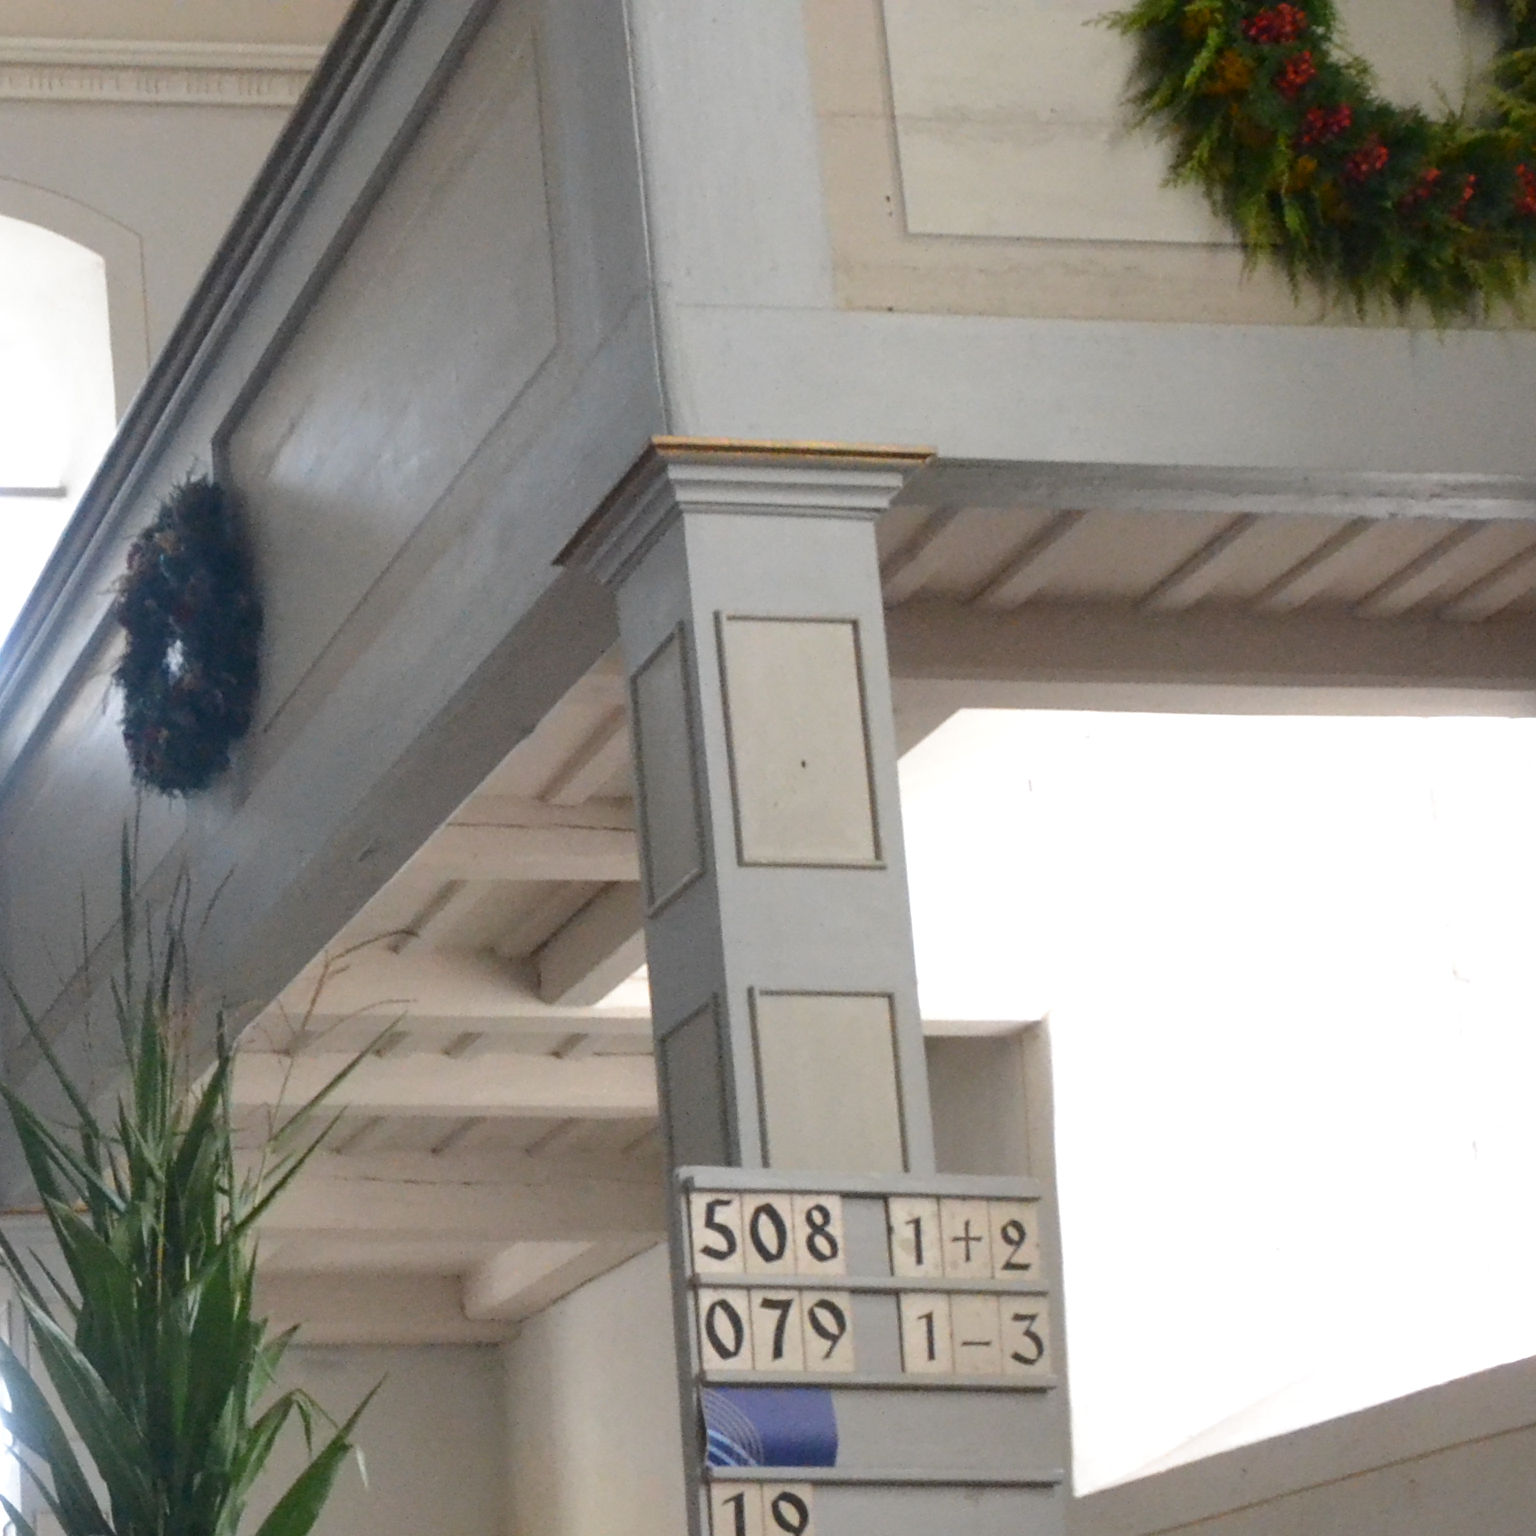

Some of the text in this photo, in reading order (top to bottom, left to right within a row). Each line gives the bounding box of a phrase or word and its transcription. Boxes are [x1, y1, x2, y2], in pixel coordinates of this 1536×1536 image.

[700, 1198, 1032, 1271] 508 1+2
[704, 1297, 847, 1361] 079
